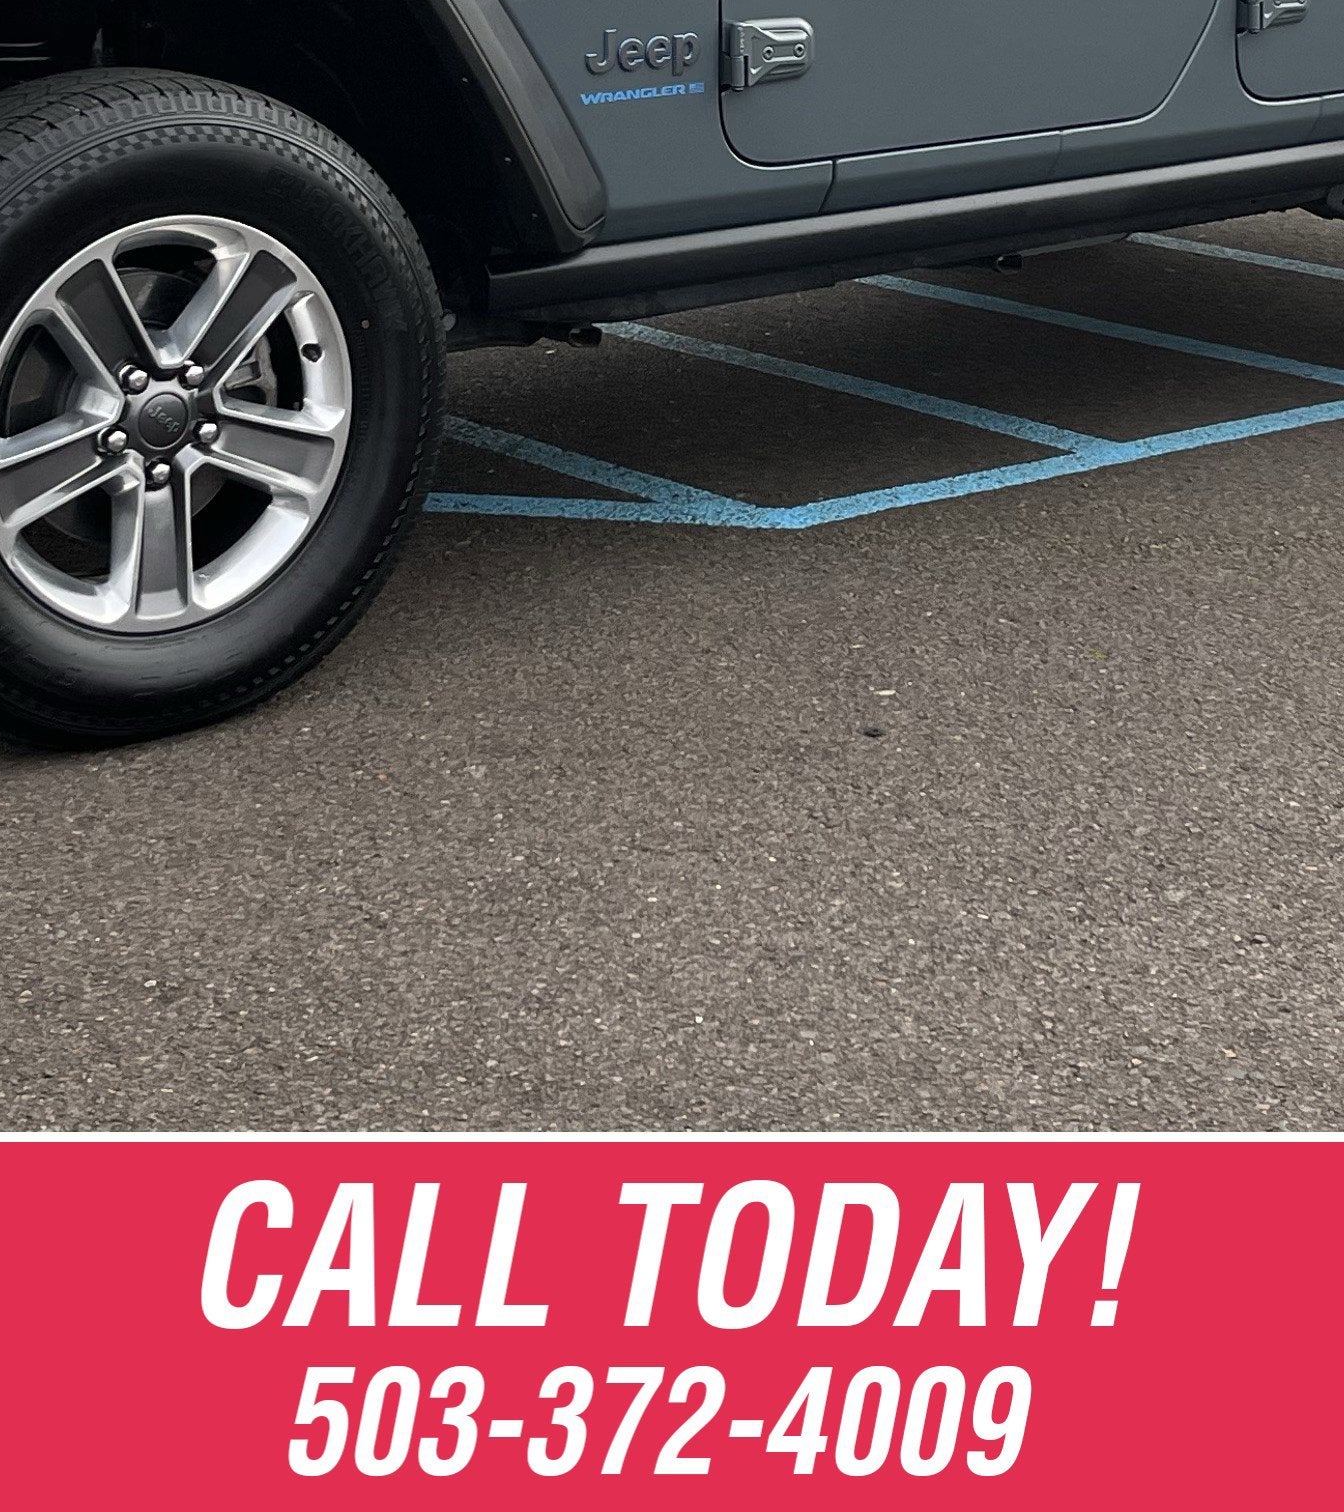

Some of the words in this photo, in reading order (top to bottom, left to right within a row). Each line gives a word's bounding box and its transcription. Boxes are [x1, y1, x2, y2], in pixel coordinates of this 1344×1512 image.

[584, 28, 702, 76] Jeep
[580, 84, 686, 105] WRANGLER
[148, 406, 180, 433] Jeep
